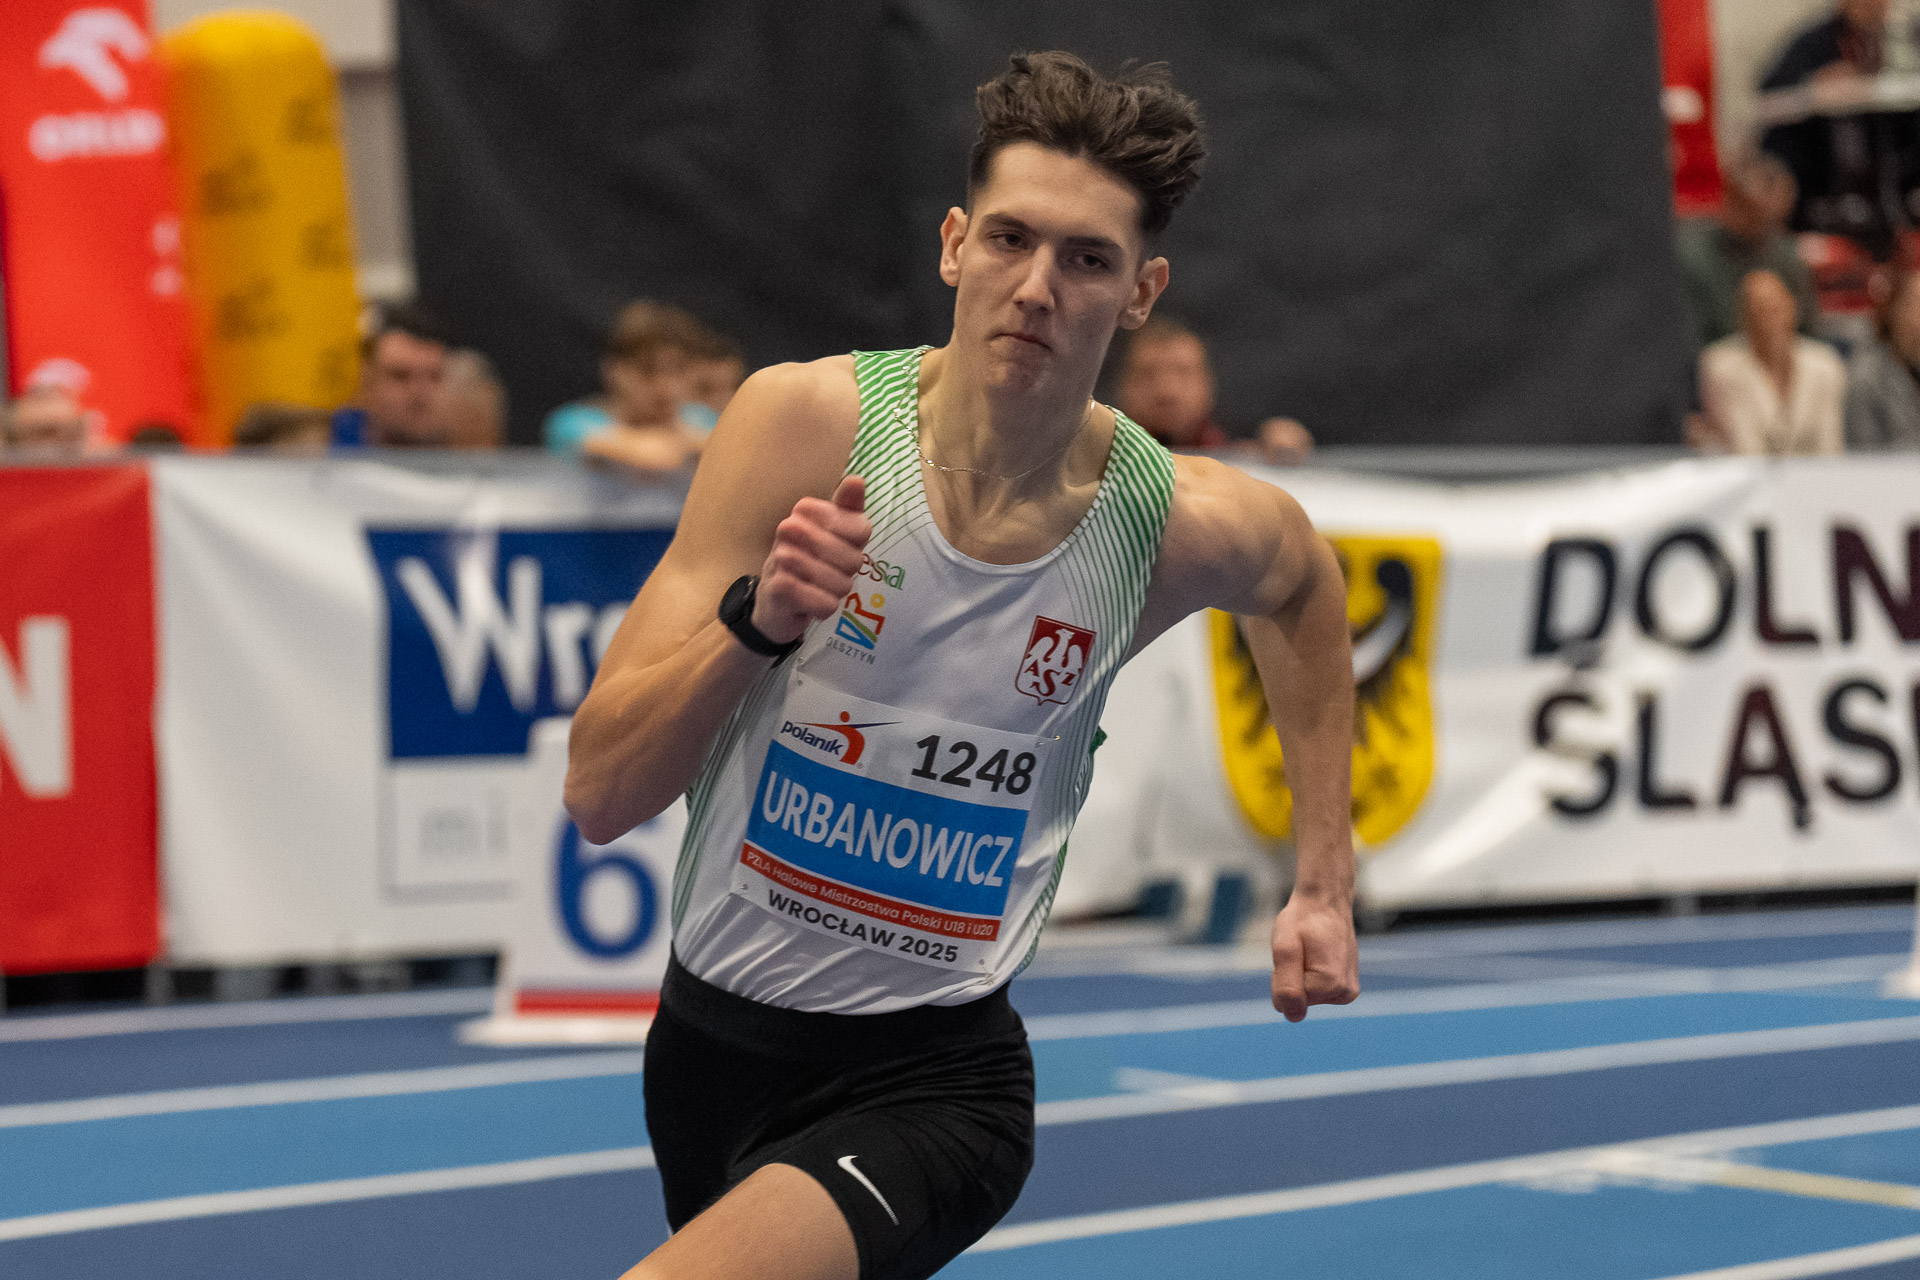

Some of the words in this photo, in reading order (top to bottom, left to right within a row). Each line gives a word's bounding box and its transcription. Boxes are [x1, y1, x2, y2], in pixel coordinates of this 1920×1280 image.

[826, 636, 876, 665] OLSZTYN
[780, 721, 844, 755] polanik
[911, 735, 1036, 795] 1248
[1531, 645, 1920, 833] ŚLĄS
[762, 770, 1014, 887] URBANOWICZ
[551, 805, 660, 960] 6
[747, 851, 771, 873] PZLA
[772, 866, 818, 893] Halowe
[820, 886, 899, 919] Mistrzostwa
[902, 910, 941, 929] Polski
[943, 921, 965, 933] U18
[972, 924, 994, 936] U20
[769, 889, 896, 947] WROCŁAW
[898, 935, 958, 962] 2025
